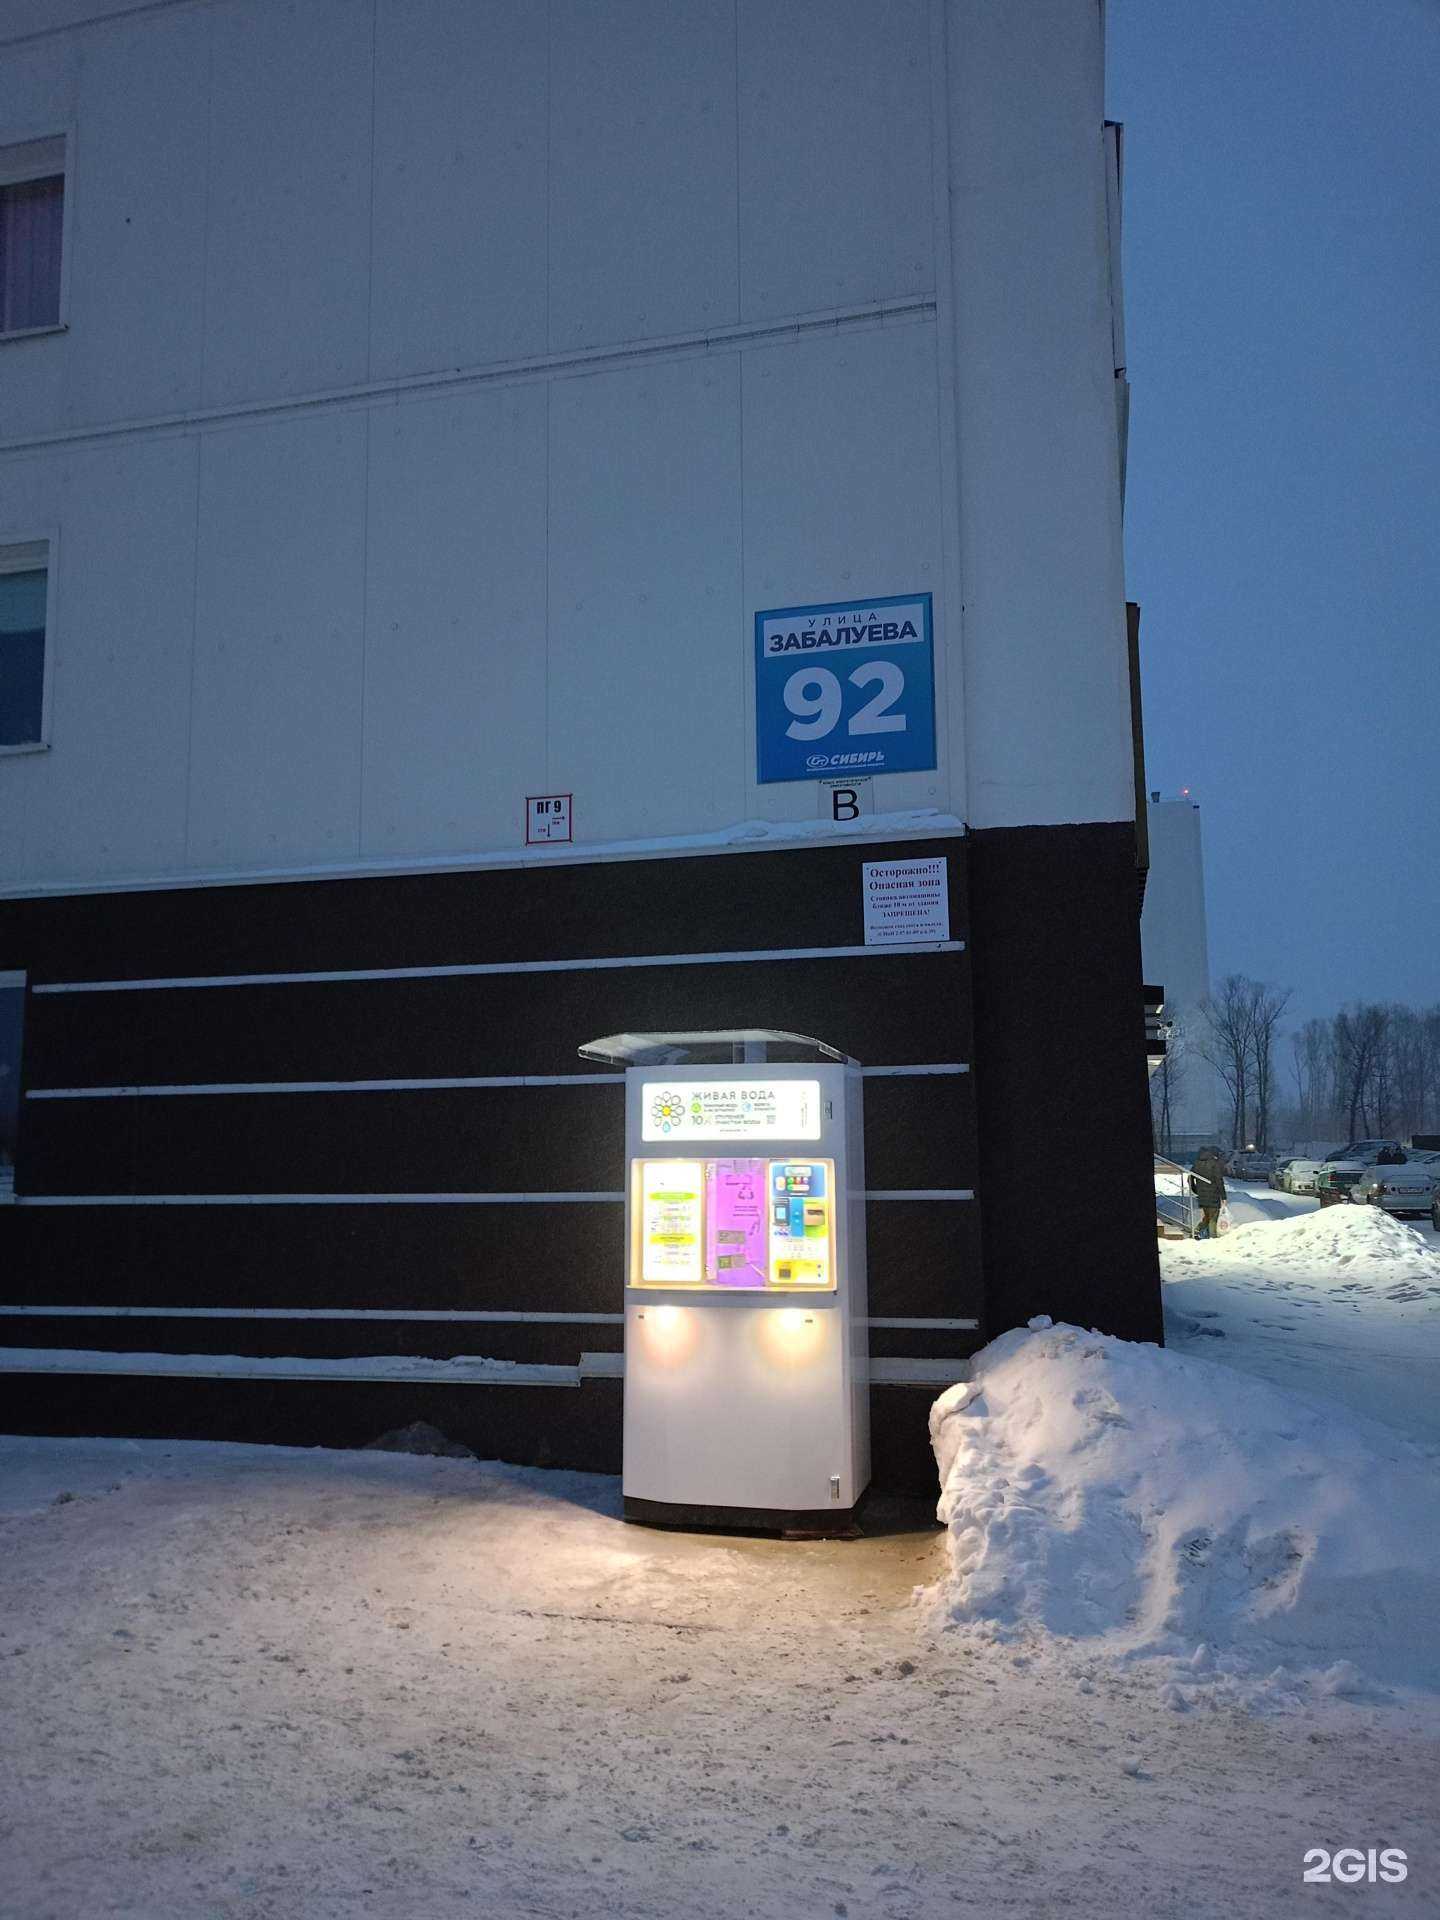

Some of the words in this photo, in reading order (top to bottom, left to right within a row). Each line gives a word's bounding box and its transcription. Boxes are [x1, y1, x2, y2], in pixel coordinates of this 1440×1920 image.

[808, 612, 879, 628] УЛИЦА
[769, 621, 918, 652] ЗАБАЛУЕВА
[783, 660, 907, 741] 92
[830, 751, 885, 765] СИБИРЬ
[553, 800, 562, 813] 9
[870, 864, 940, 878] Осторожно!!!
[869, 880, 914, 890] Опасная
[917, 879, 941, 887] зона
[692, 1091, 736, 1101] ЖИВАЯ
[741, 1090, 776, 1100] ВОДА
